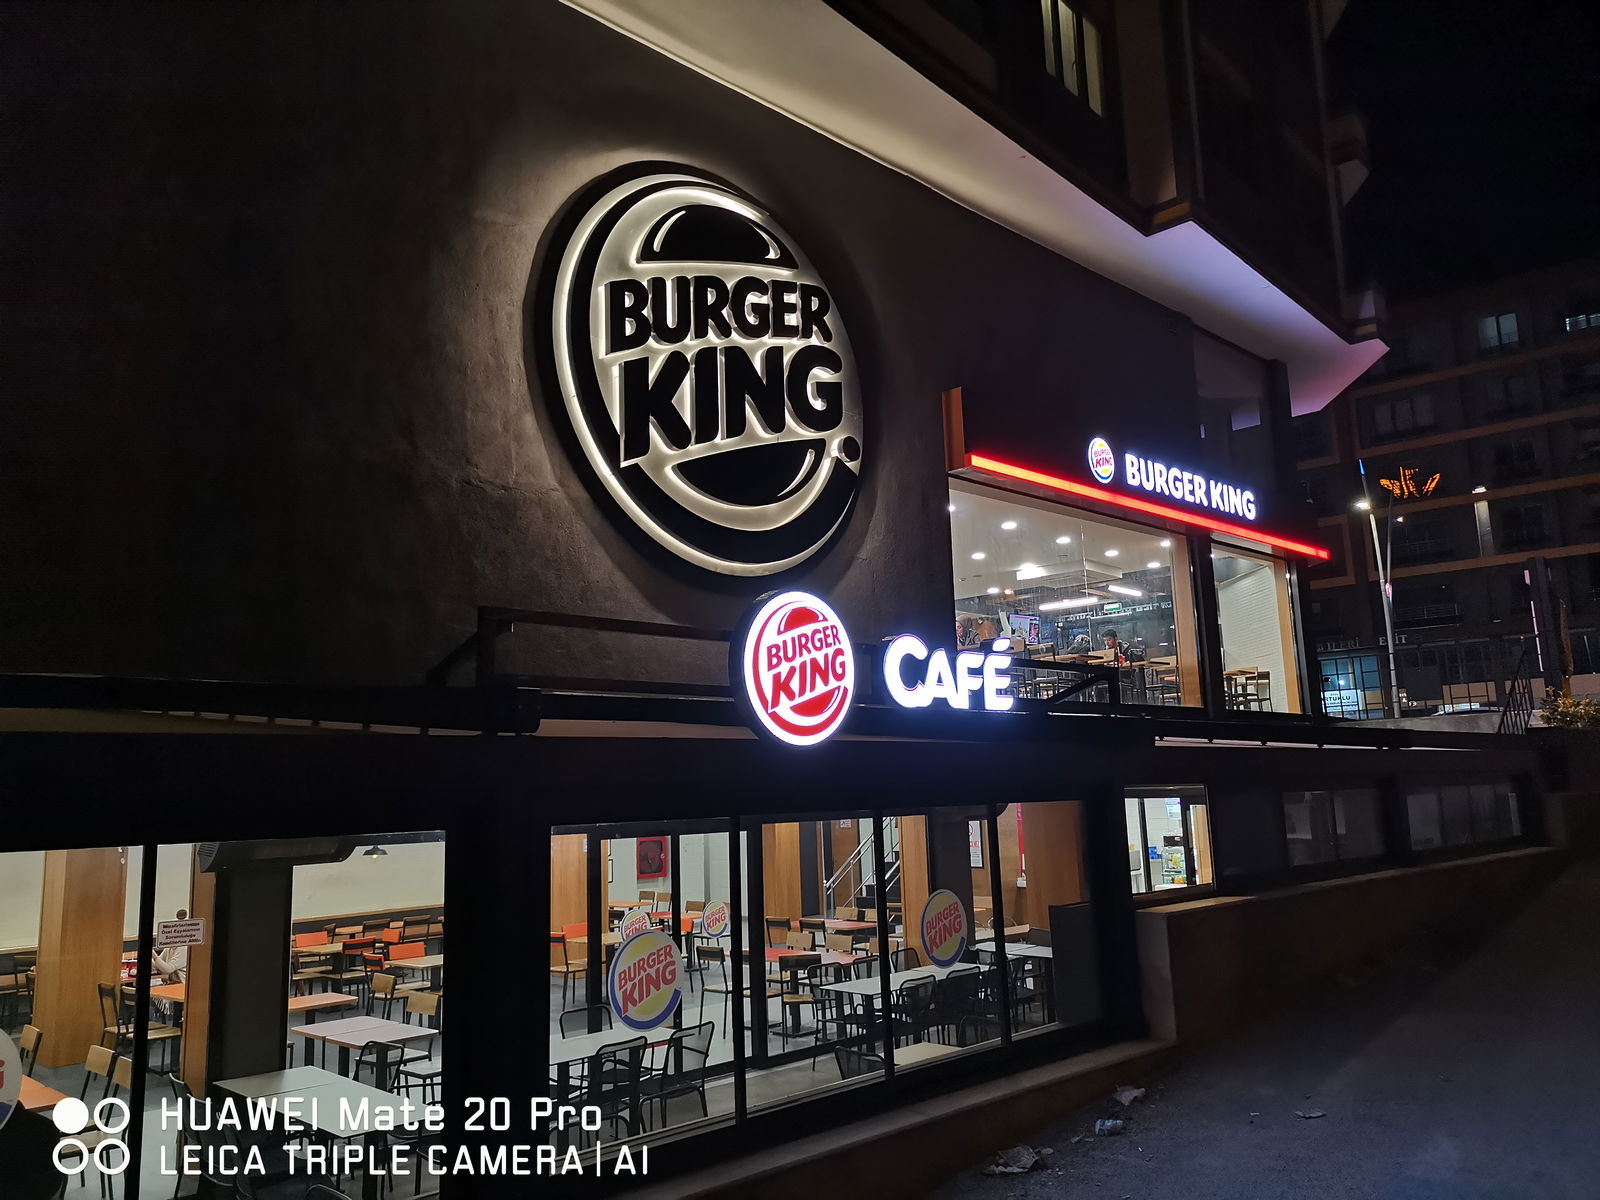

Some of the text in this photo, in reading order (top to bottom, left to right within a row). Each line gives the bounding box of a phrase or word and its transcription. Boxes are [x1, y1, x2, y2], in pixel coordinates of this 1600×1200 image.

[603, 275, 832, 354] BURGER
[618, 346, 843, 467] KING
[1094, 449, 1111, 457] BURGE
[1125, 453, 1256, 521] BURGER KING
[766, 624, 841, 672] BURGER
[1379, 633, 1408, 646] EİT
[770, 647, 846, 710] KING
[883, 633, 1014, 710] CAFÉ
[623, 915, 646, 933] BURGER
[705, 905, 725, 921] BURGER
[706, 912, 726, 931] KING
[926, 901, 960, 936] BURGER
[928, 914, 963, 955] KING
[618, 944, 674, 992] BURGER
[621, 960, 676, 1015] KING
